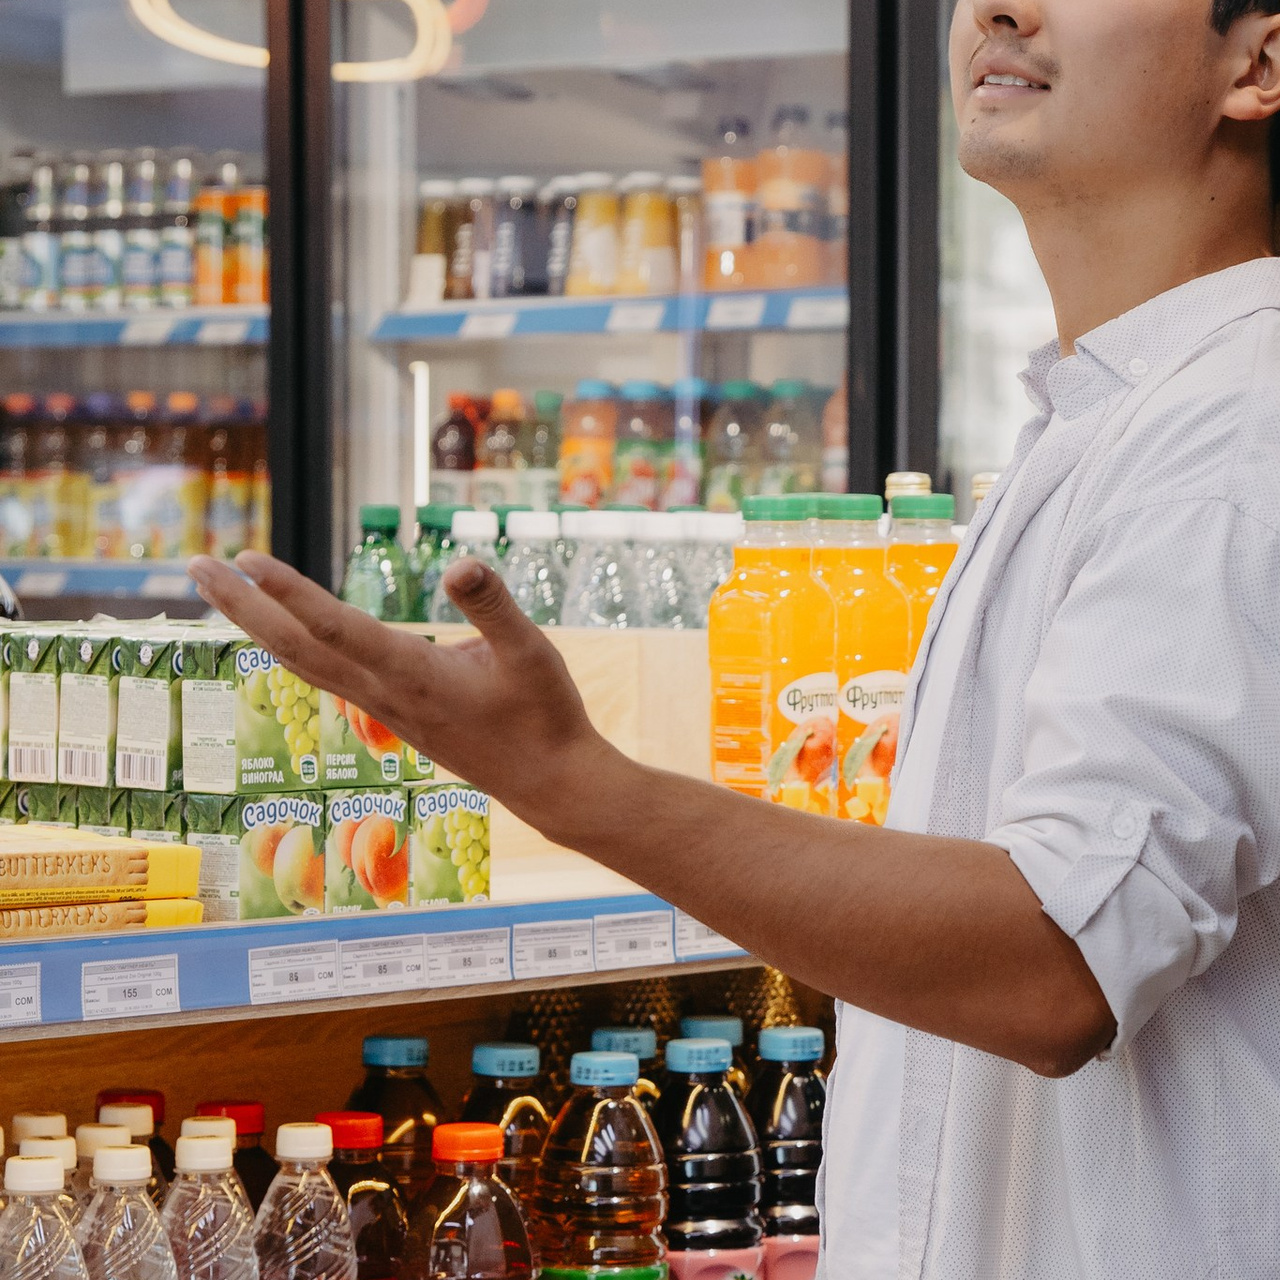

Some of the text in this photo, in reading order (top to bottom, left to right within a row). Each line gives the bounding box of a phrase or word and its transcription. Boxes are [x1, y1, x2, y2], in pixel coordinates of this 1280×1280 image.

[241, 757, 275, 770] ЯБЛОКО
[326, 754, 356, 766] ПЕРСИК
[241, 771, 284, 784] ВИНОГРАД
[325, 768, 358, 780] ЯБЛОКО
[331, 794, 405, 823] Садочок
[416, 790, 489, 818] Садочок
[243, 797, 321, 827] Садочок
[0, 905, 108, 929] UTTERKEKS
[122, 987, 173, 999] 155 СОМ
[15, 996, 33, 1006] СОМ
